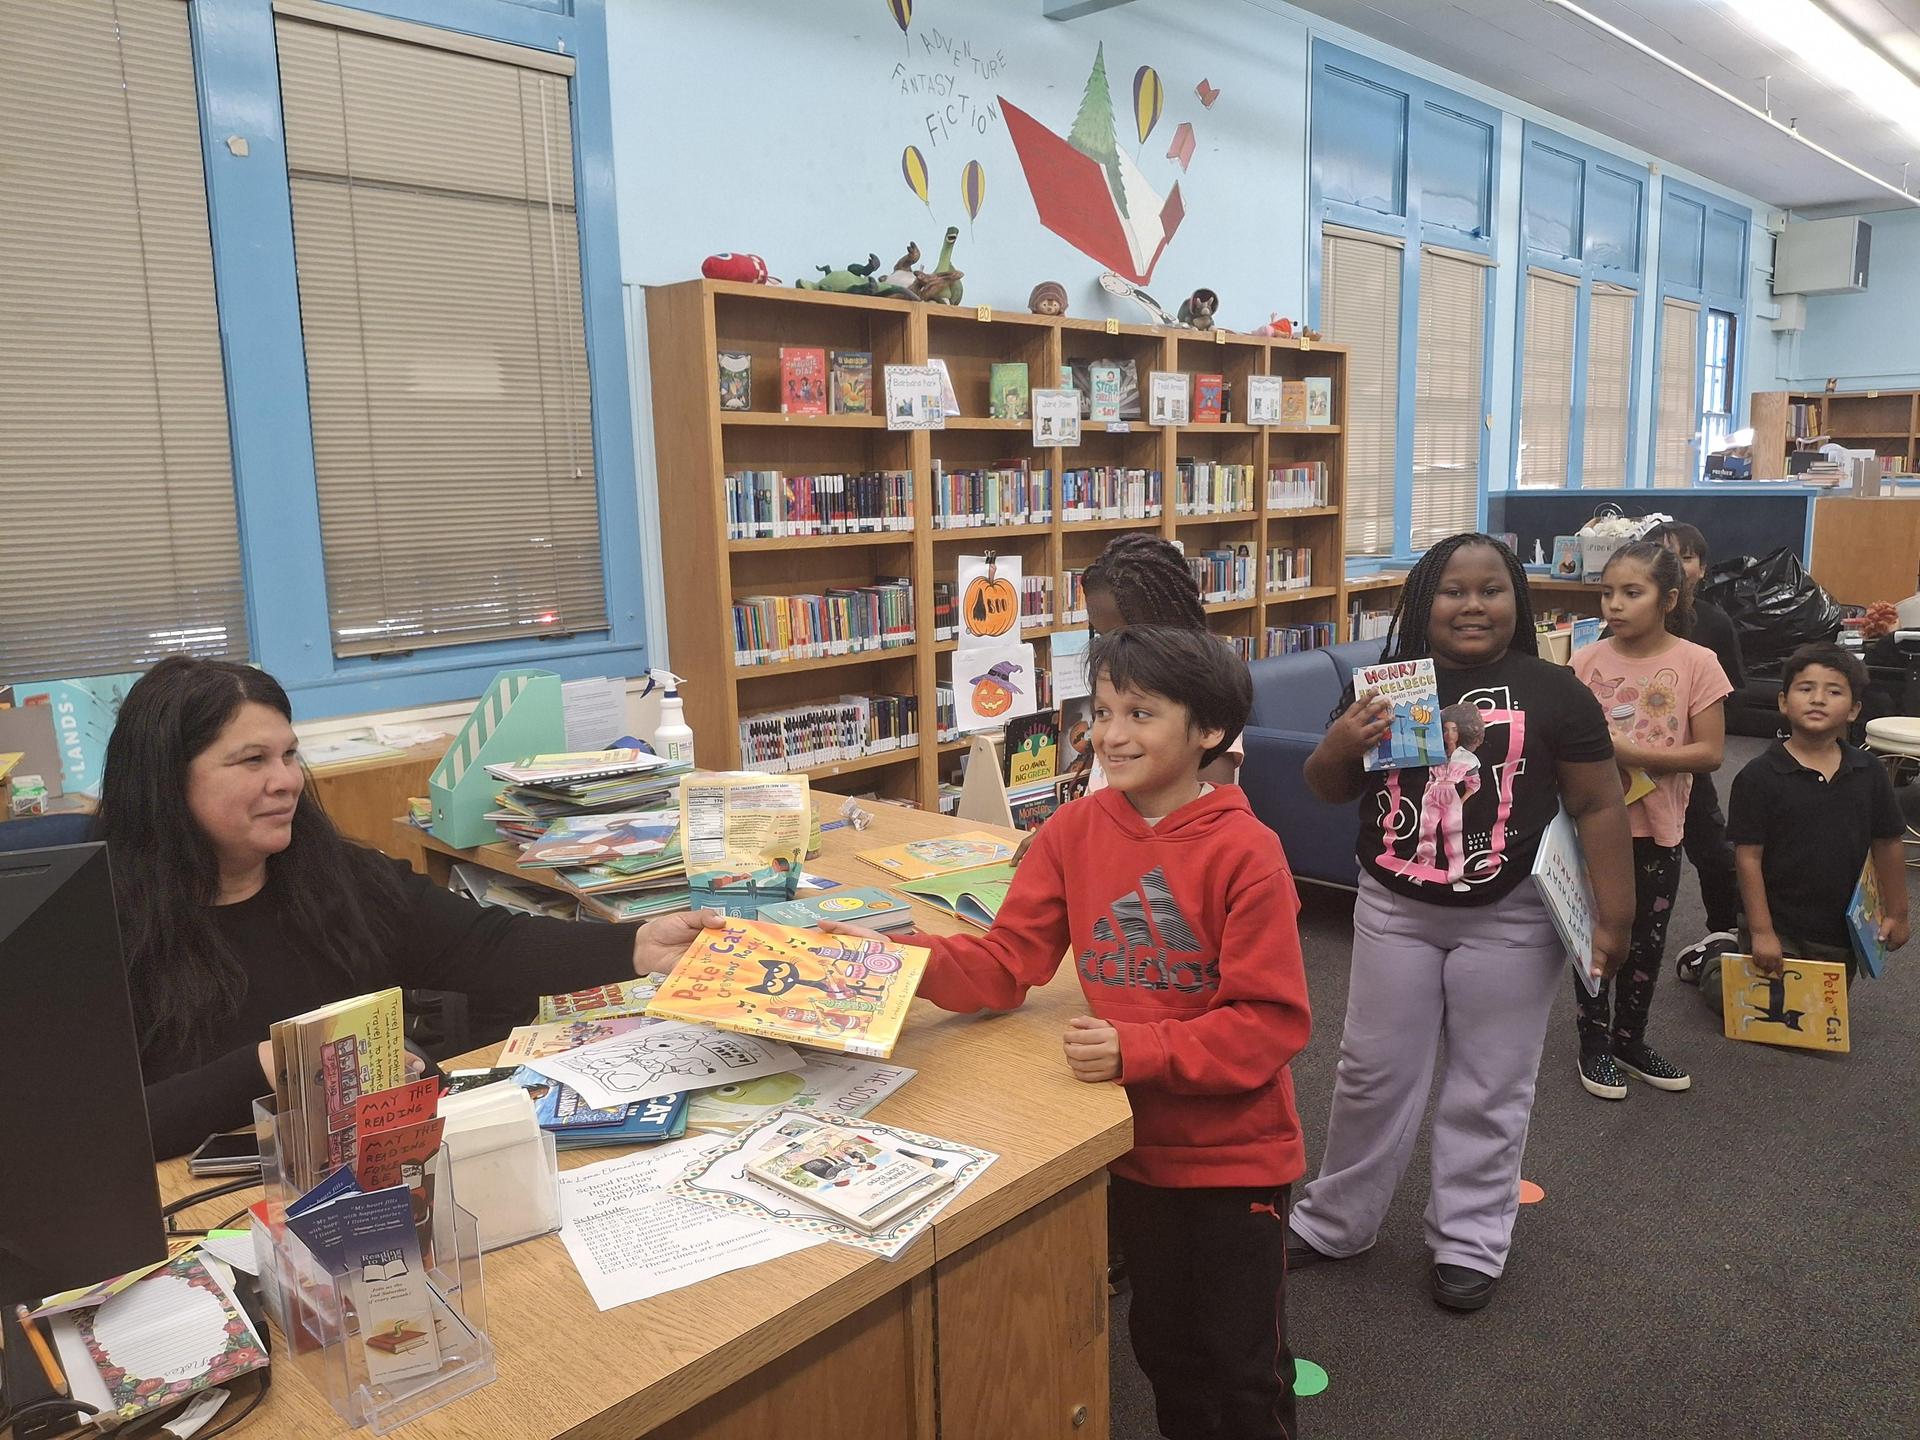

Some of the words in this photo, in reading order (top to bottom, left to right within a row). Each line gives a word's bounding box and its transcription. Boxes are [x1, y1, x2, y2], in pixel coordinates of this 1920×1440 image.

[921, 28, 1006, 80] ADVENTURE
[892, 62, 955, 96] FANTASY
[979, 307, 989, 320] 20
[58, 702, 87, 774] LANDS
[1015, 773, 1026, 782] BIG
[1027, 767, 1051, 779] GREEN
[1019, 764, 1030, 772] GO
[671, 966, 720, 1001] Pete
[700, 953, 712, 964] the
[709, 927, 747, 954] Cat
[1079, 941, 1221, 993] adidas
[1823, 972, 1840, 1006] Pete
[372, 1008, 382, 1040] Travel
[391, 998, 400, 1031] Travel
[392, 1036, 399, 1045] to
[1825, 1017, 1842, 1043] Cat
[375, 1046, 381, 1056] to
[375, 1059, 383, 1090] Anothe
[393, 1048, 401, 1083] Another
[864, 1069, 903, 1086] THE
[362, 1094, 399, 1114] MAY
[409, 1083, 433, 1102] THE
[639, 1093, 677, 1125] CAT
[829, 1086, 878, 1111] SOUR
[365, 1104, 422, 1128] READING
[366, 1134, 402, 1152] MAY
[415, 1123, 439, 1138] THE
[367, 1141, 425, 1163] READING
[365, 1162, 399, 1176] FORCE
[372, 1173, 391, 1186] BE
[575, 1180, 614, 1194] School
[617, 1168, 658, 1183] Portrait
[588, 1183, 628, 1196] Picture
[631, 1175, 652, 1186] Day
[598, 1182, 649, 1199] Schedule
[593, 1185, 661, 1207] 10/09/2024
[644, 1237, 668, 1246] Break
[648, 1240, 674, 1250] Lopez
[652, 1244, 680, 1254] Garcia
[673, 1250, 698, 1260] times
[716, 1228, 769, 1248] approximate
[690, 1240, 710, 1249] Ford
[361, 1248, 402, 1261] Reading
[654, 1266, 677, 1277] Thank
[679, 1261, 693, 1269] you
